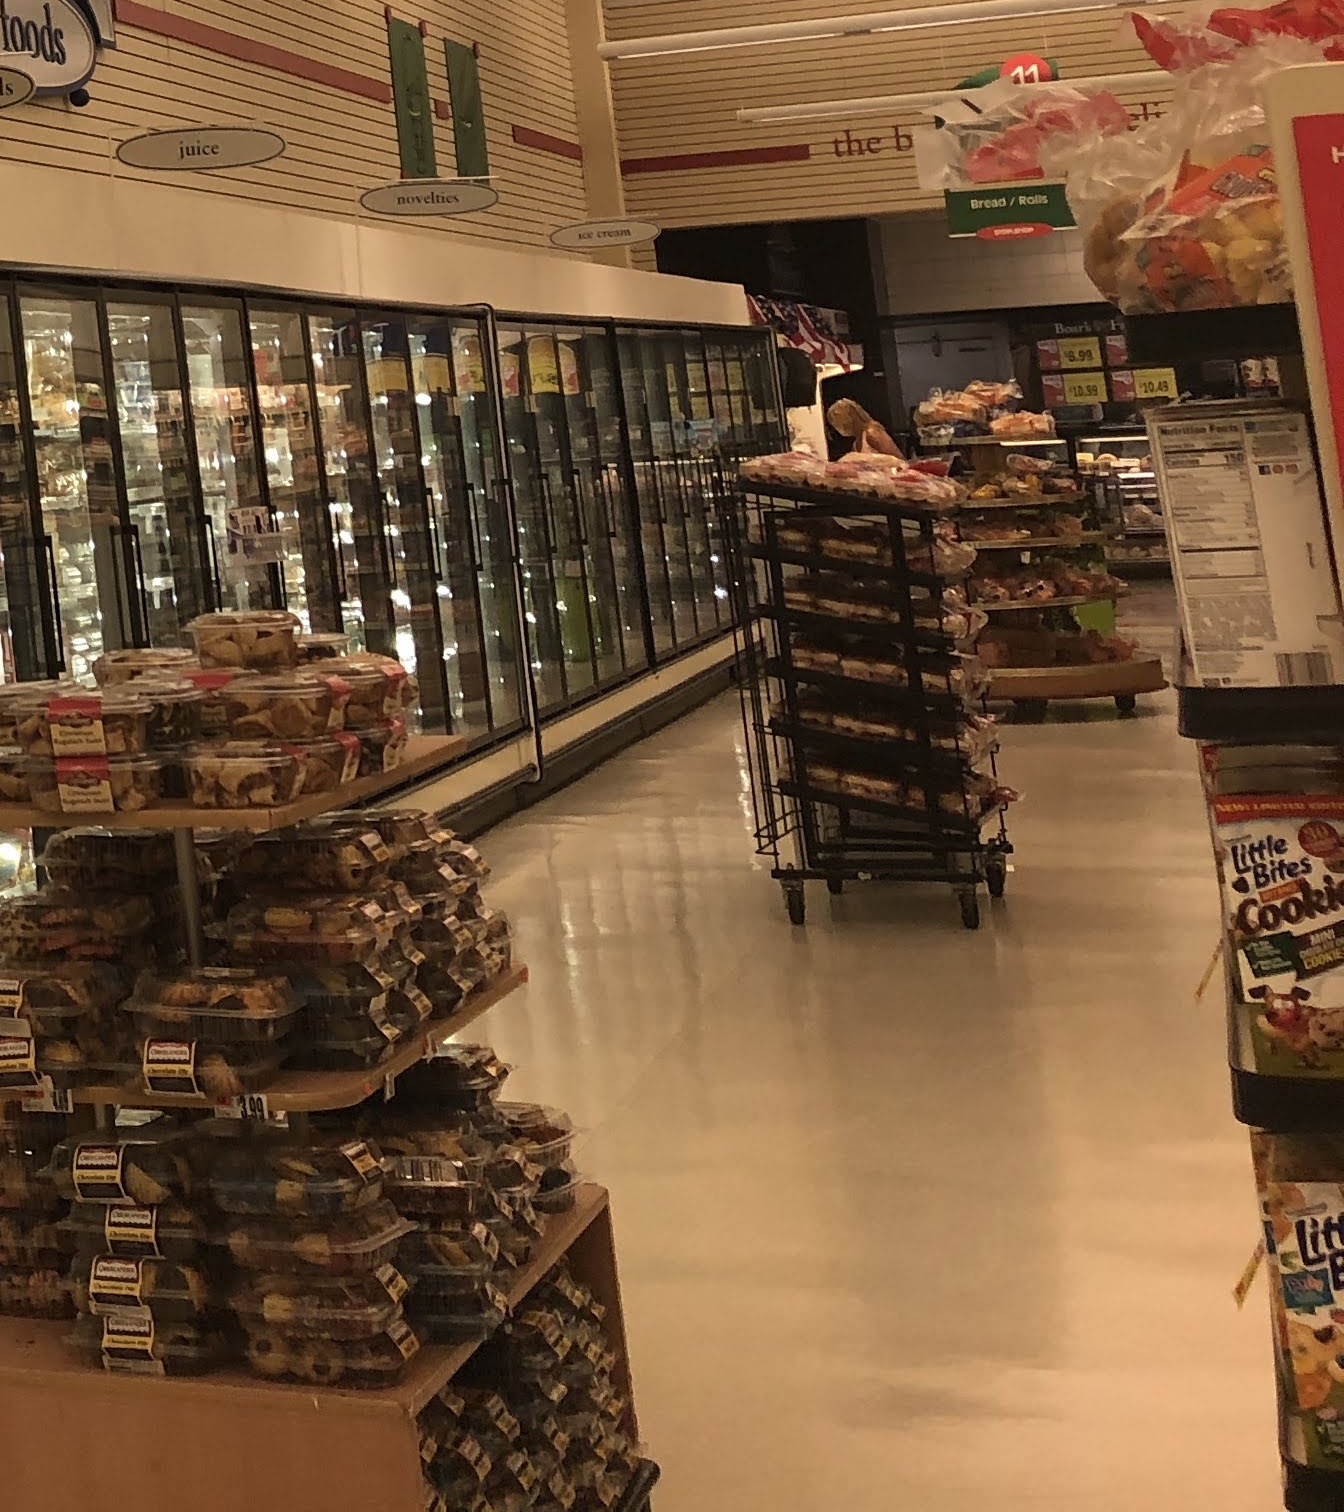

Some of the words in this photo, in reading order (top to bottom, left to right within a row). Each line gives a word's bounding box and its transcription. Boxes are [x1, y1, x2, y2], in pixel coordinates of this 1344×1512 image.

[1011, 63, 1039, 85] 11
[177, 138, 221, 161] juice
[832, 128, 882, 158] the
[395, 189, 461, 208] novelties
[971, 196, 1006, 210] Bread
[1019, 194, 1049, 206] Rolls
[597, 229, 632, 238] cream
[1230, 834, 1288, 875] Little
[1253, 857, 1312, 889] Bites
